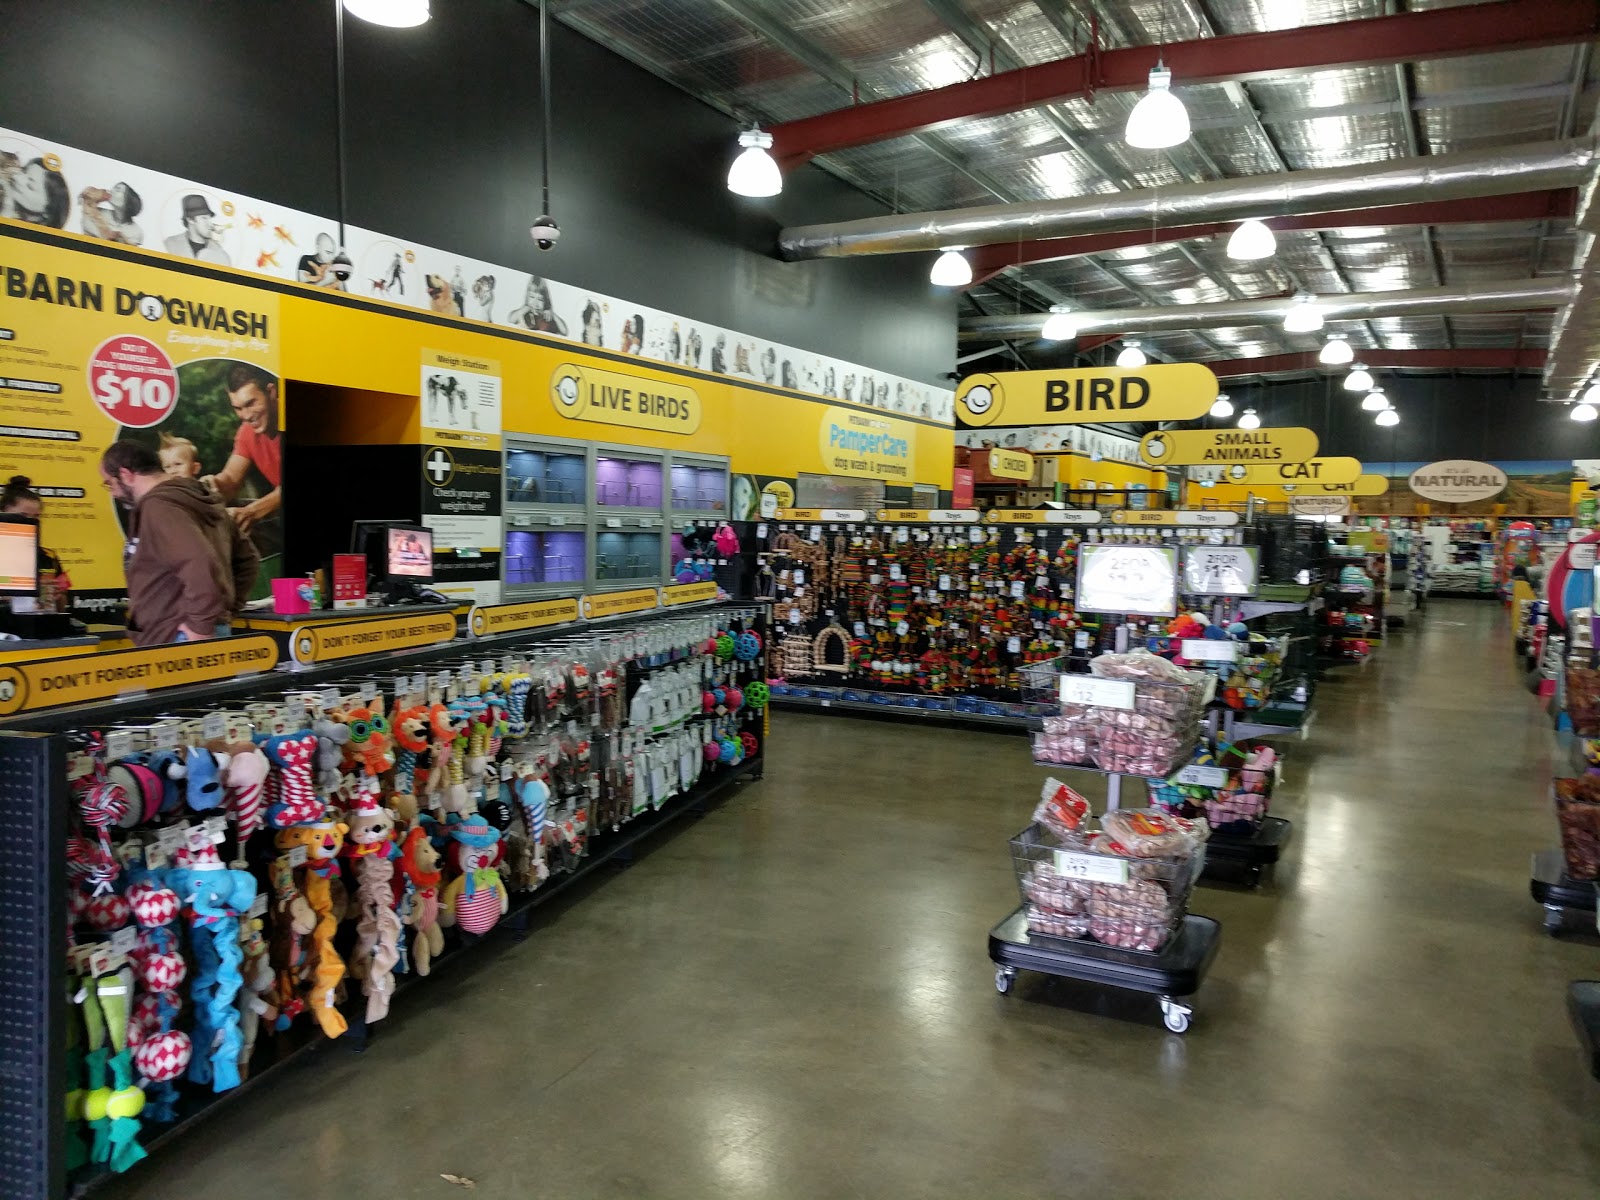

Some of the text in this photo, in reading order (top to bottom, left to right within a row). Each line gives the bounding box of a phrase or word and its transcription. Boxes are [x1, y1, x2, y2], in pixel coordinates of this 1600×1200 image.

[0, 265, 104, 312] BARN
[96, 369, 172, 409] $10
[1045, 376, 1150, 412] BIRD
[590, 383, 690, 421] LIVE BIRDS
[830, 423, 908, 458] PamperCare
[1215, 432, 1272, 446] SMALL
[1203, 447, 1282, 460] ANIMALS
[1279, 463, 1323, 478] CAT
[1414, 475, 1502, 487] NATURAL
[835, 511, 851, 519] Toys
[899, 511, 962, 520] BIRD Toys
[1013, 512, 1082, 521] BIRD Toys
[1140, 513, 1217, 522] BIRD Toys
[322, 622, 452, 648] DON'T FORGET YOUR BEST FRIEND
[41, 647, 271, 691] DON'T FORGET YOUR BEST FRIEND
